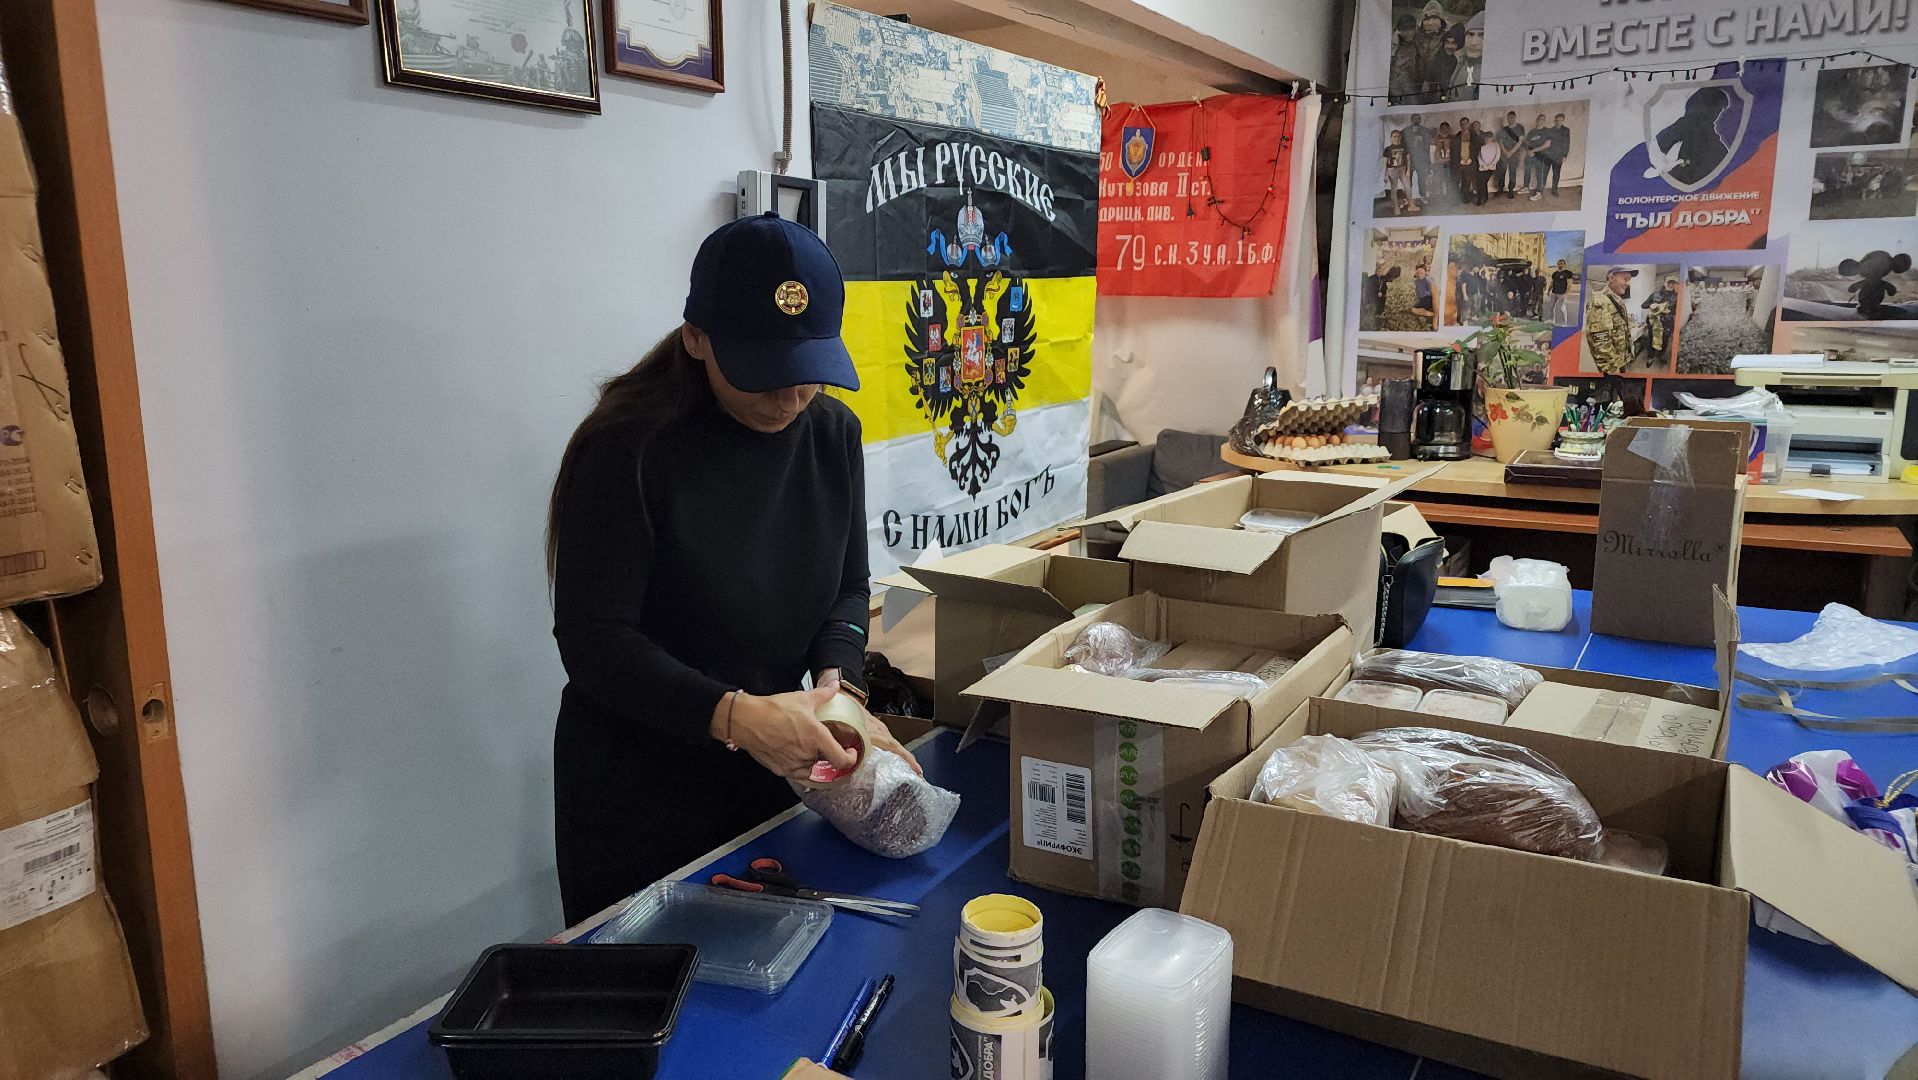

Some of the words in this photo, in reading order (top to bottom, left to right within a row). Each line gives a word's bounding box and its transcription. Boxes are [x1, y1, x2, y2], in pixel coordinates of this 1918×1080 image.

[1522, 14, 1695, 63] ВМЕСТЕ
[1705, 9, 1735, 46] С
[1746, 0, 1909, 43] НАМИ!
[866, 146, 927, 214] МЫ
[935, 142, 1057, 222] РУССКИЕ
[1618, 193, 1699, 205] ВОЛОНТЕРСКОЕ
[1700, 191, 1760, 202] ДВИЖЕНИЕ
[1615, 211, 1672, 229] "ТЫЛ
[1674, 208, 1762, 229] ДОБРА"
[1115, 234, 1146, 271] 79
[1185, 241, 1199, 265] 3
[882, 509, 903, 548] С
[910, 504, 990, 550] НАМИ
[995, 464, 1056, 532] БОГЪ
[1603, 530, 1712, 562] Mirrolla
